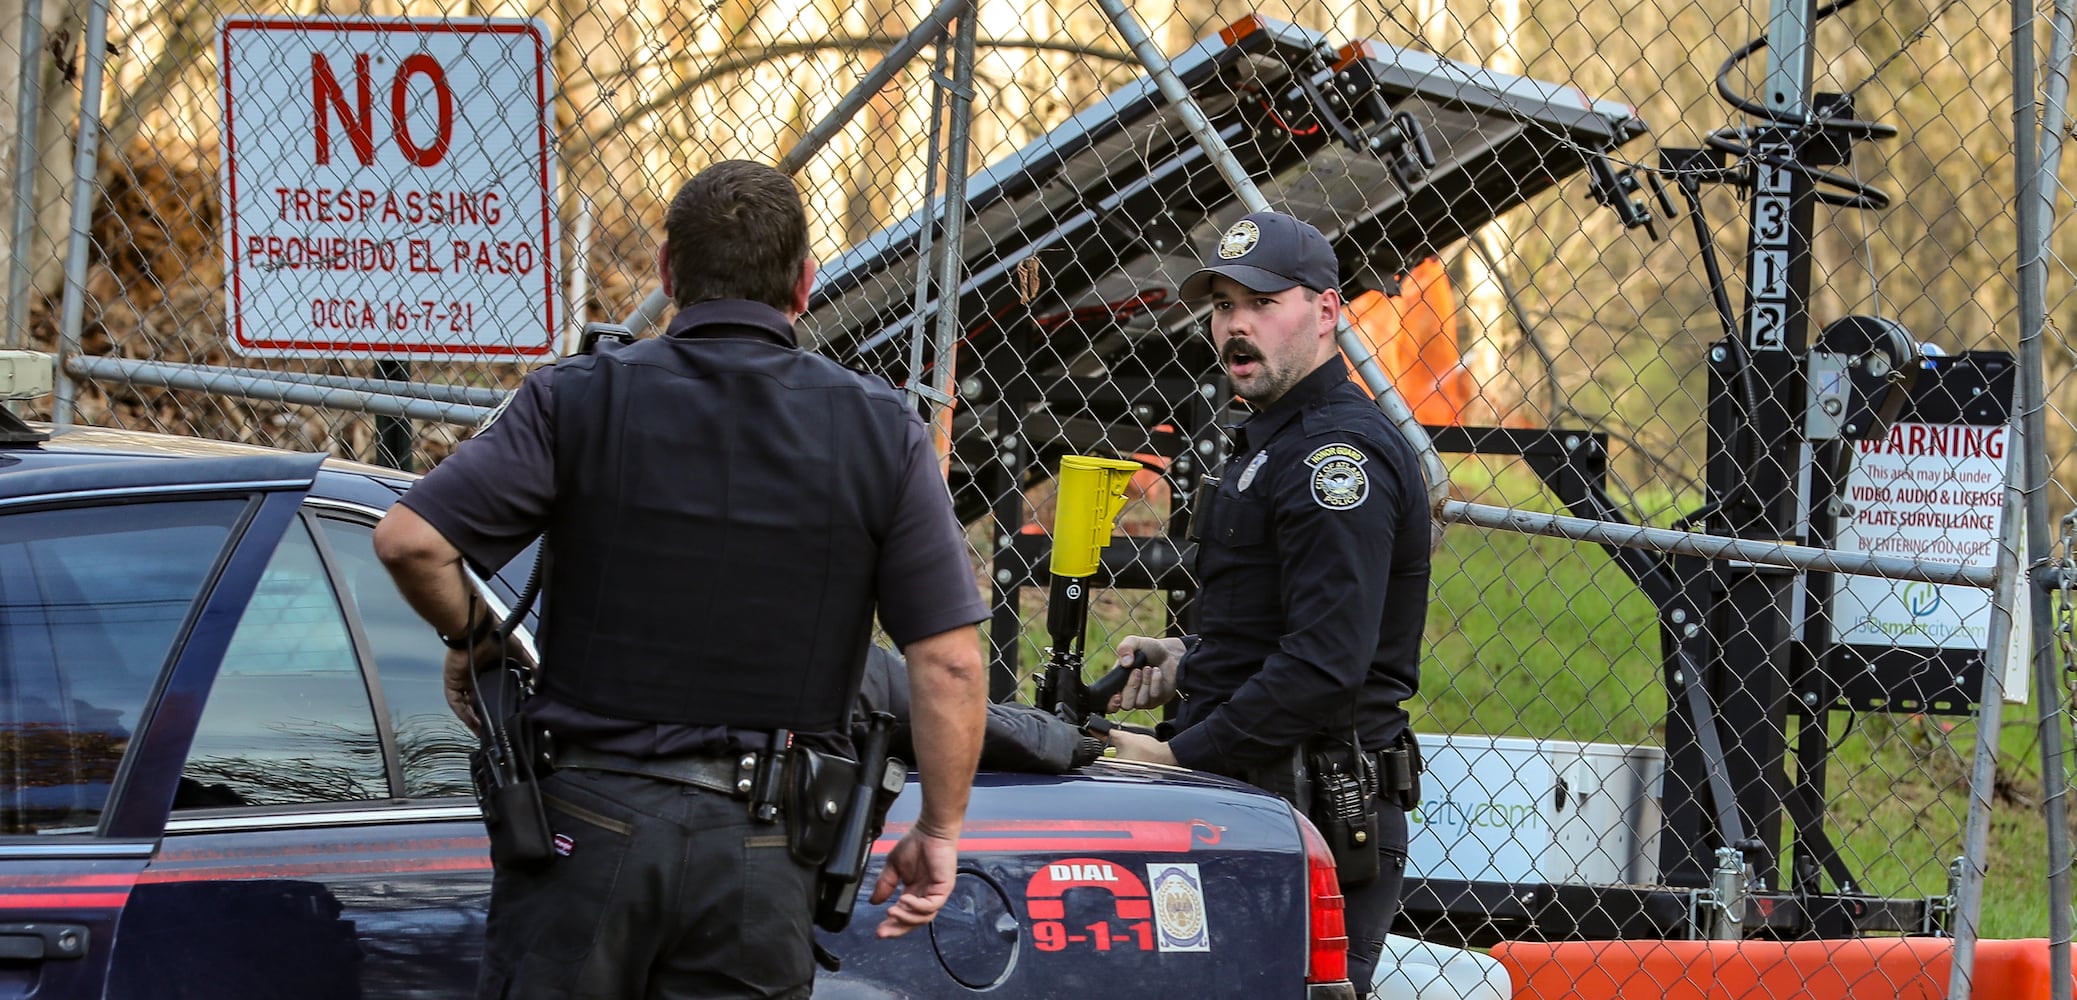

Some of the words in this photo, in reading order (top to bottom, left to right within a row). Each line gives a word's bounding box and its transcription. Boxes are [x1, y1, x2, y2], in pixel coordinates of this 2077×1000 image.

[312, 53, 453, 168] NO
[275, 188, 500, 225] TRESPASSING
[248, 236, 396, 272] PROHIBIDO
[409, 239, 442, 273] EL
[454, 240, 534, 275] PASO
[312, 298, 376, 330] OCGA
[385, 301, 474, 332] 16-7-21
[1311, 447, 1336, 463] HONOR
[1315, 472, 1325, 490] CITY
[1322, 463, 1335, 472] OF
[1867, 464, 1888, 480] This
[1890, 470, 1914, 481] area
[1916, 470, 1941, 484] may
[1943, 468, 1956, 481] be
[1959, 470, 1992, 483] under
[1323, 493, 1360, 506] POLICE
[1852, 486, 1893, 505] VIDEO,
[1897, 488, 1938, 503] AUDIO
[1940, 490, 1950, 504] &
[1953, 490, 2004, 507] LICENSE
[1859, 510, 1897, 526] PLATE
[1900, 511, 1994, 530] SURVEILLANCE
[1859, 536, 1873, 550] BY
[1876, 537, 1928, 553] ENTERING
[1931, 539, 1953, 553] YOU
[1956, 541, 1991, 556] AGREE
[1854, 615, 1985, 640] ISOsmartcitycom
[1049, 864, 1119, 881] DIAL
[1032, 921, 1154, 951] 9-1-1
